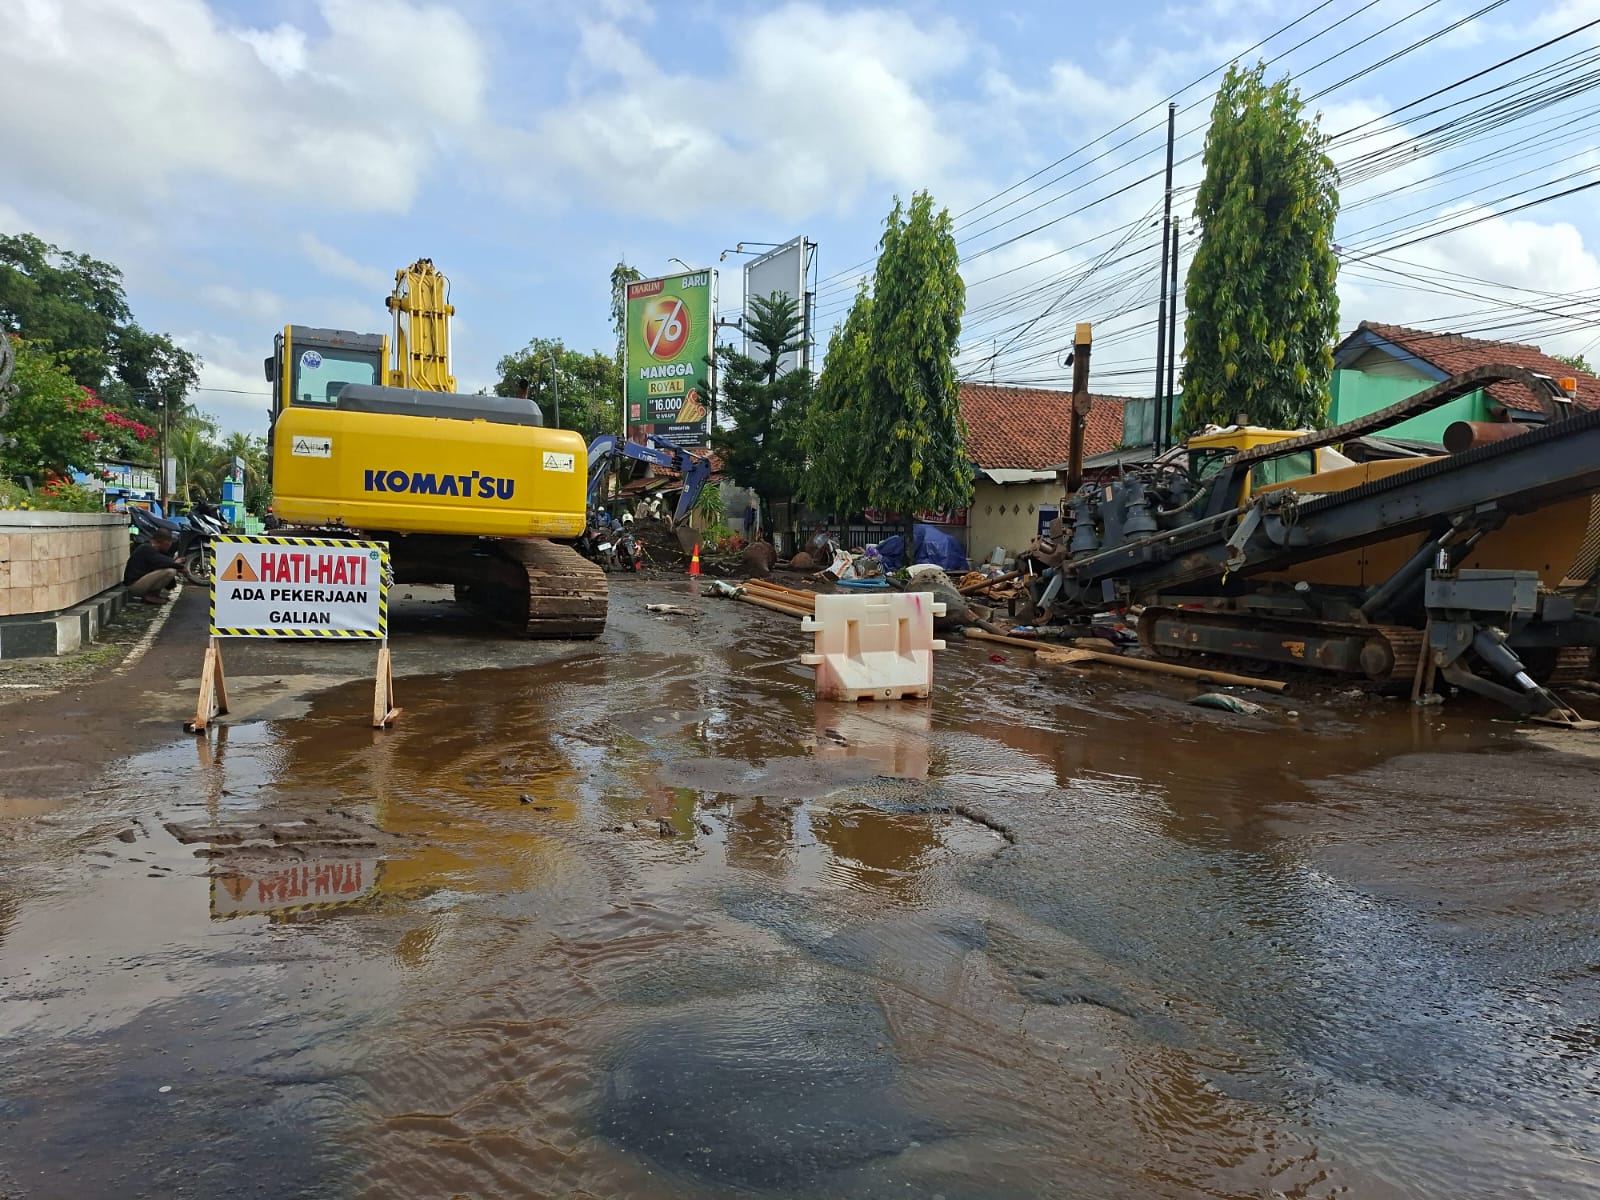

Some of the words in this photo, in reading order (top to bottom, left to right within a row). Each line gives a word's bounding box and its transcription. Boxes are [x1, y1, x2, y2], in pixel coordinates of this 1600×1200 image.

[681, 273, 708, 289] BARU
[640, 362, 694, 380] MANGGA
[650, 382, 682, 393] ROYAL
[655, 398, 682, 411] 16.000
[365, 469, 515, 500] KOMATSU
[260, 552, 367, 586] HATI-HATI
[231, 588, 265, 601] ADA
[271, 589, 368, 603] PEKERJAAN
[269, 611, 331, 624] GALIAN
